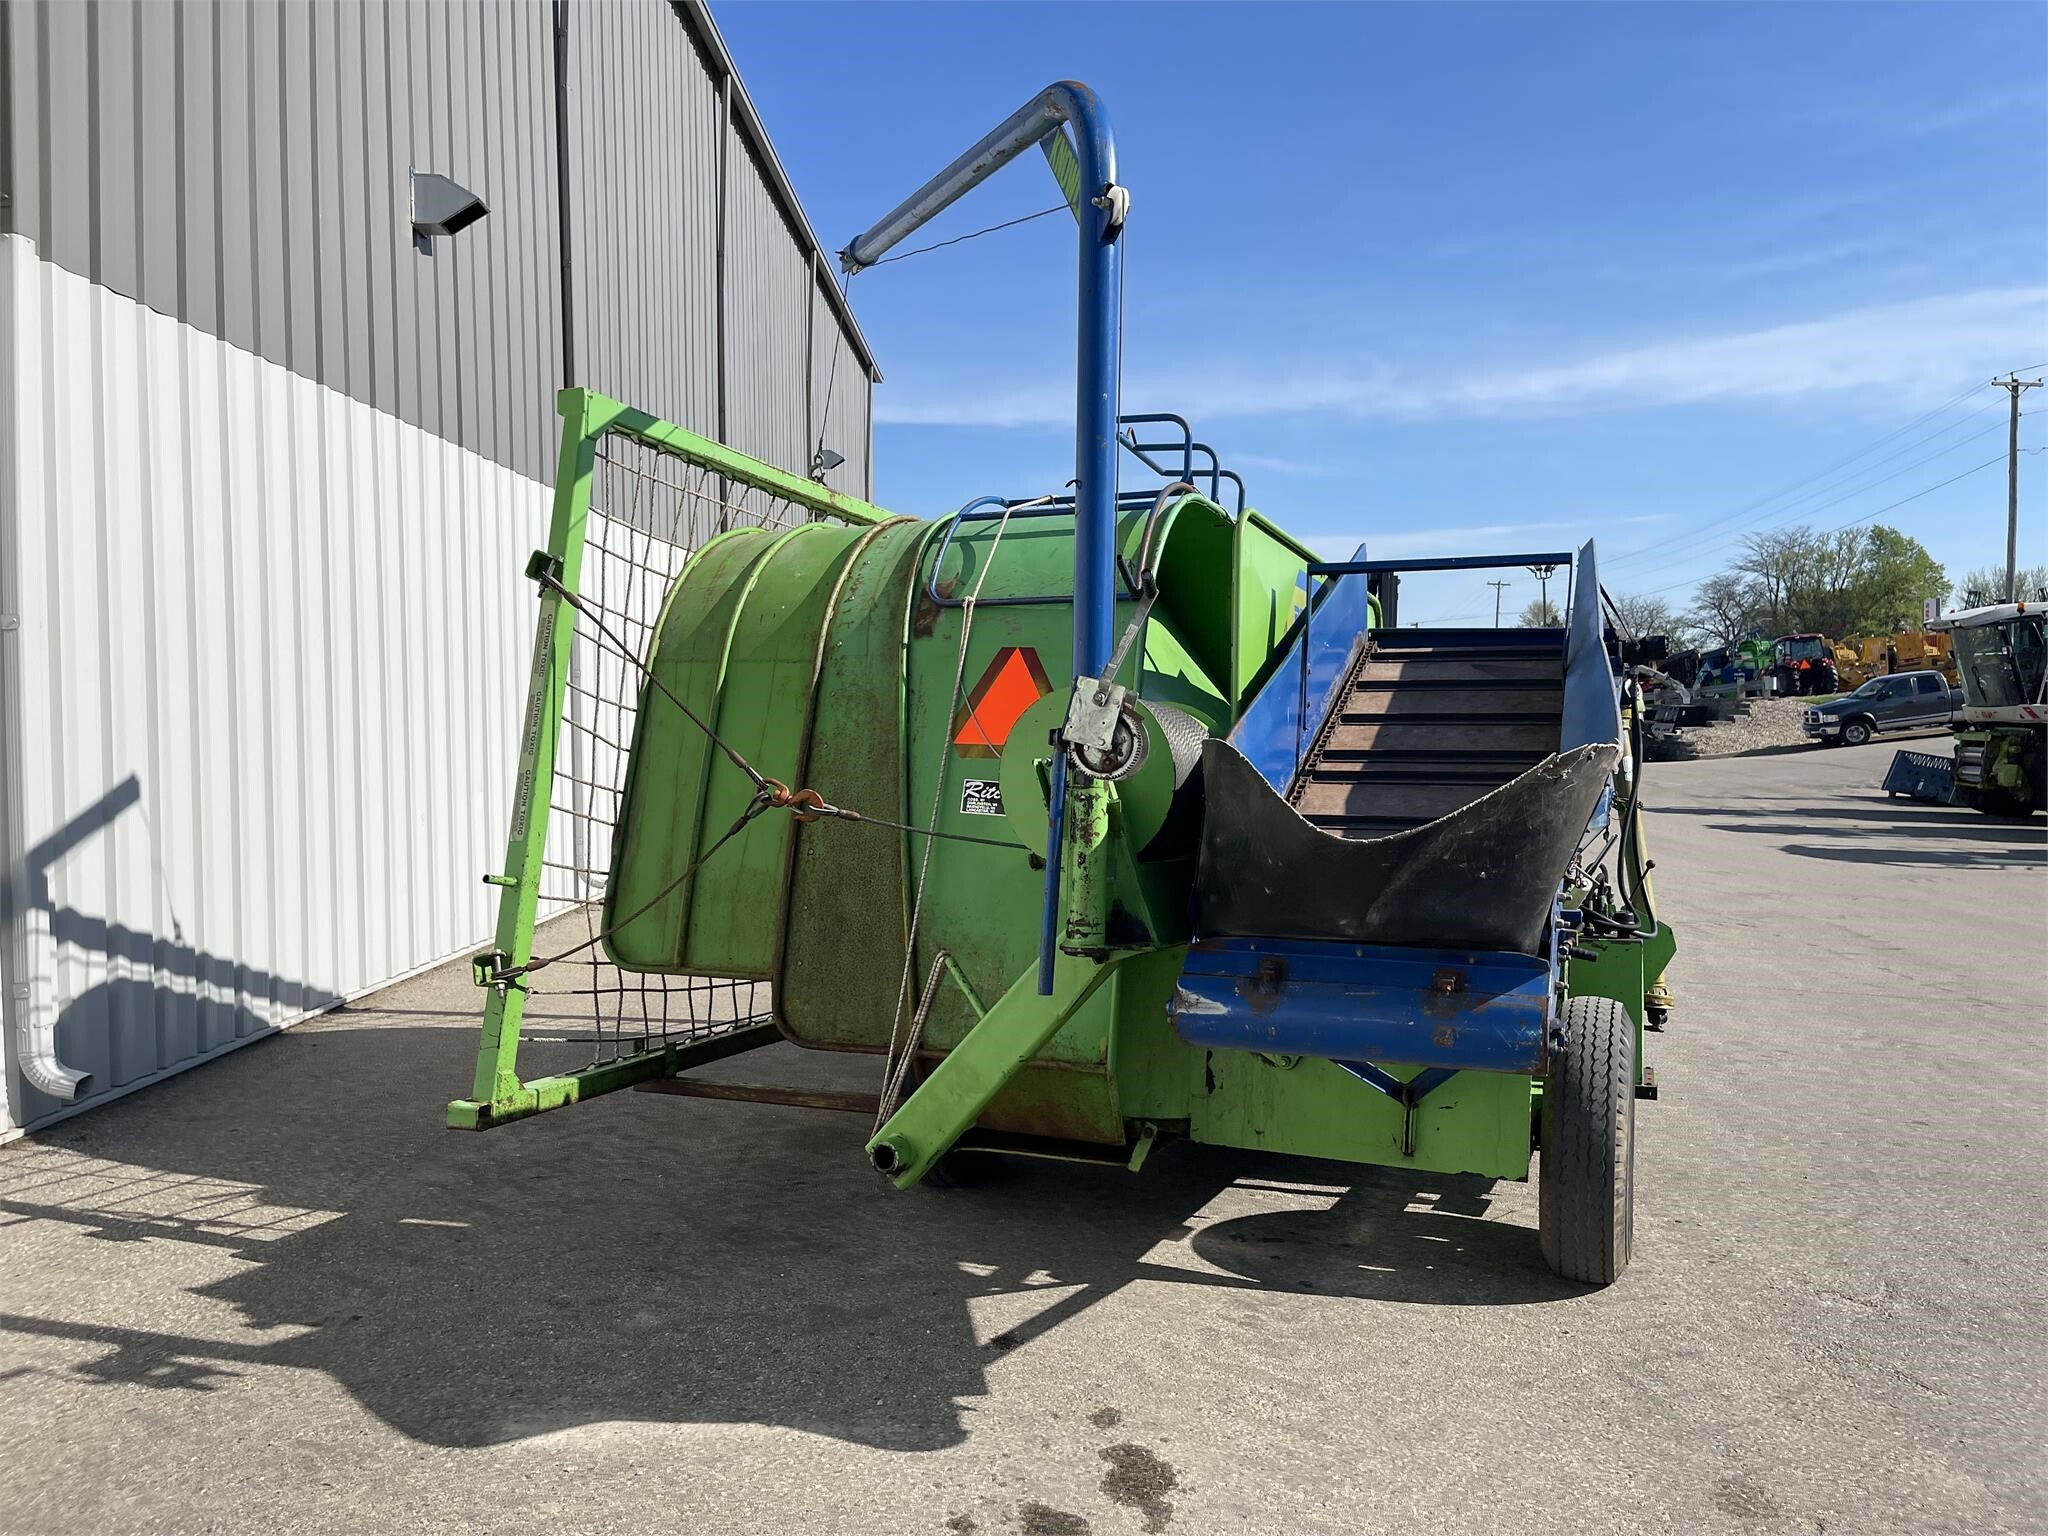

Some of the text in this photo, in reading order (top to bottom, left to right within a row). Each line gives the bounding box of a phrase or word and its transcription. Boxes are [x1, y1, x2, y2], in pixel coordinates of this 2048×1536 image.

[542, 613, 553, 650] CAUTION
[538, 653, 548, 678] TOXIC
[531, 691, 542, 730] CAUTION
[528, 731, 538, 756] TOXIC
[521, 769, 531, 808] CAUTION
[517, 810, 527, 836] TOXIC
